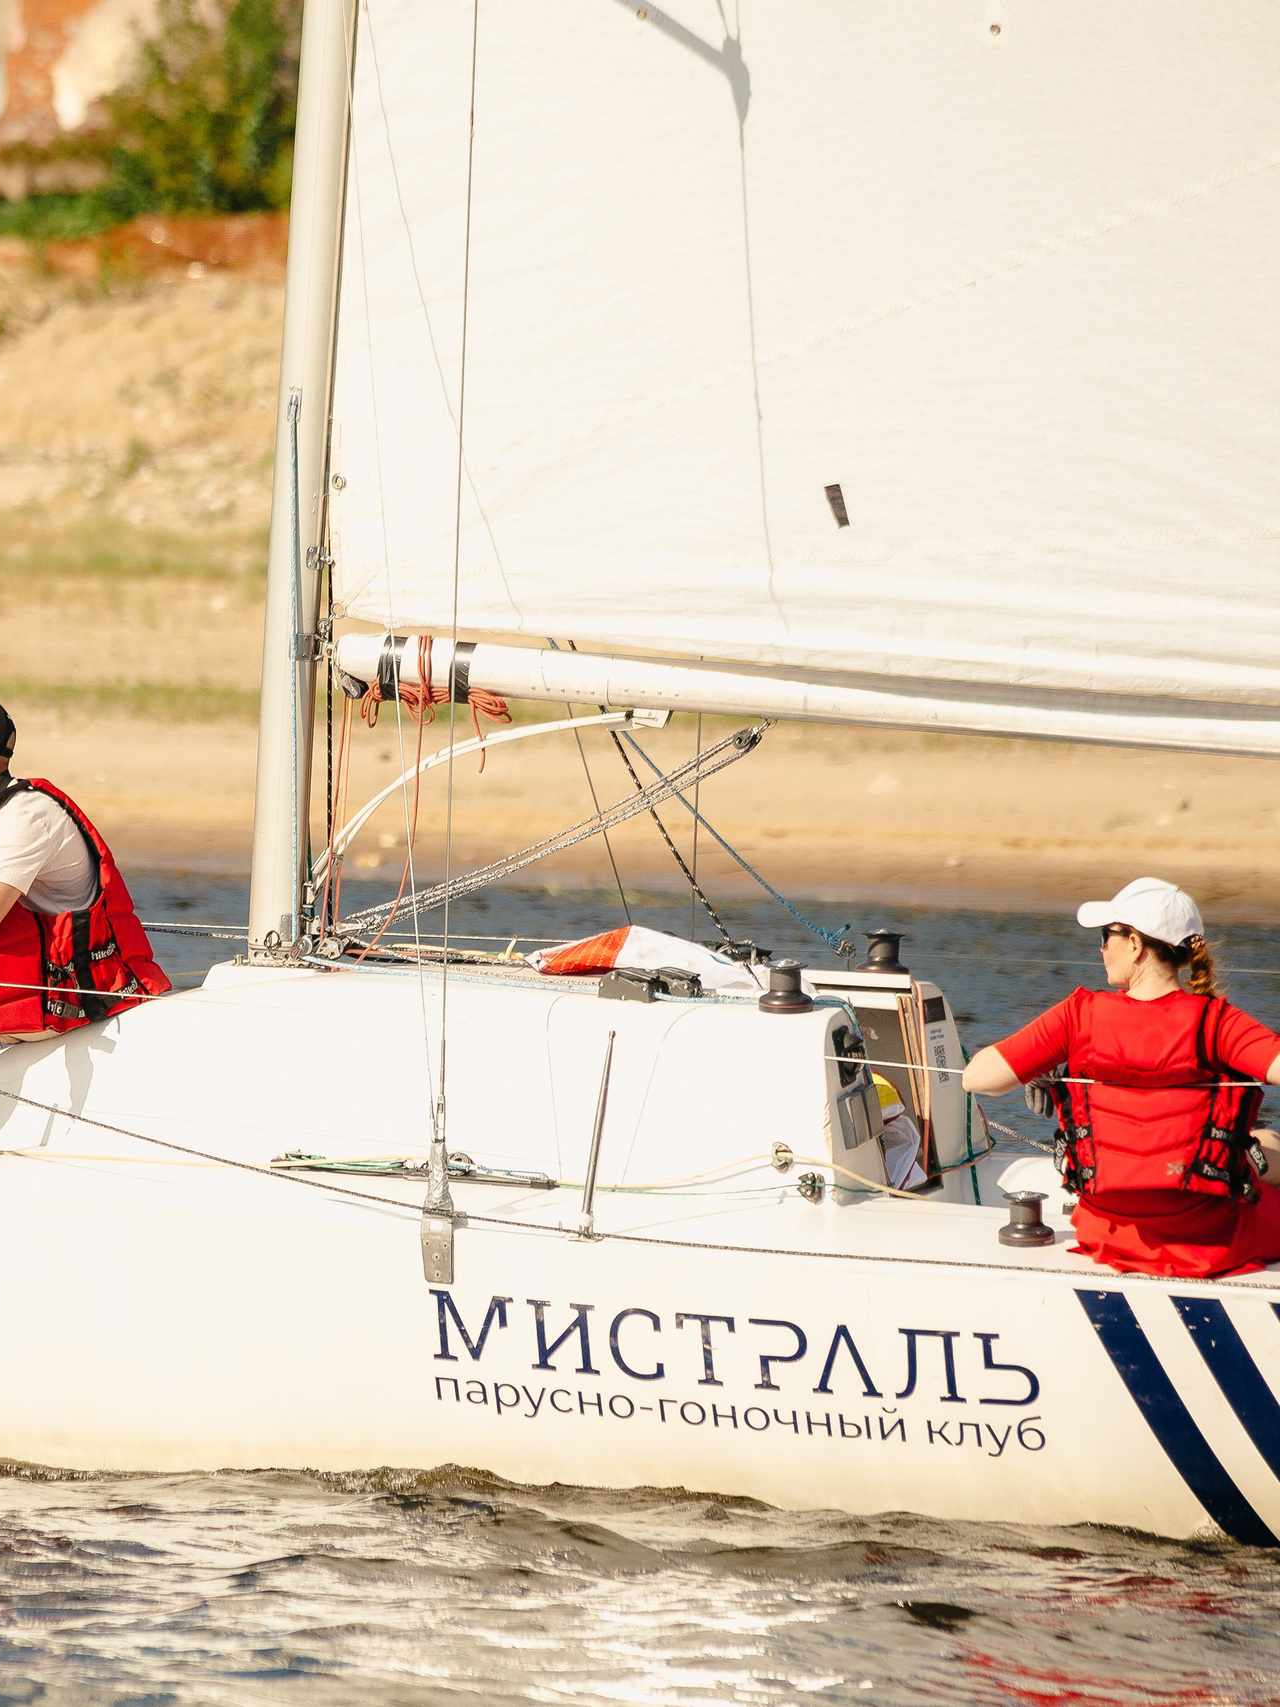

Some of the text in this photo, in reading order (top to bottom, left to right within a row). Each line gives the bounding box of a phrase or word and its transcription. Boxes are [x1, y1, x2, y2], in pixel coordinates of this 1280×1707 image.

[428, 1289, 1041, 1406] МИСТРАЛЬ
[434, 1376, 1047, 1457] парусно-гоночный клуб
